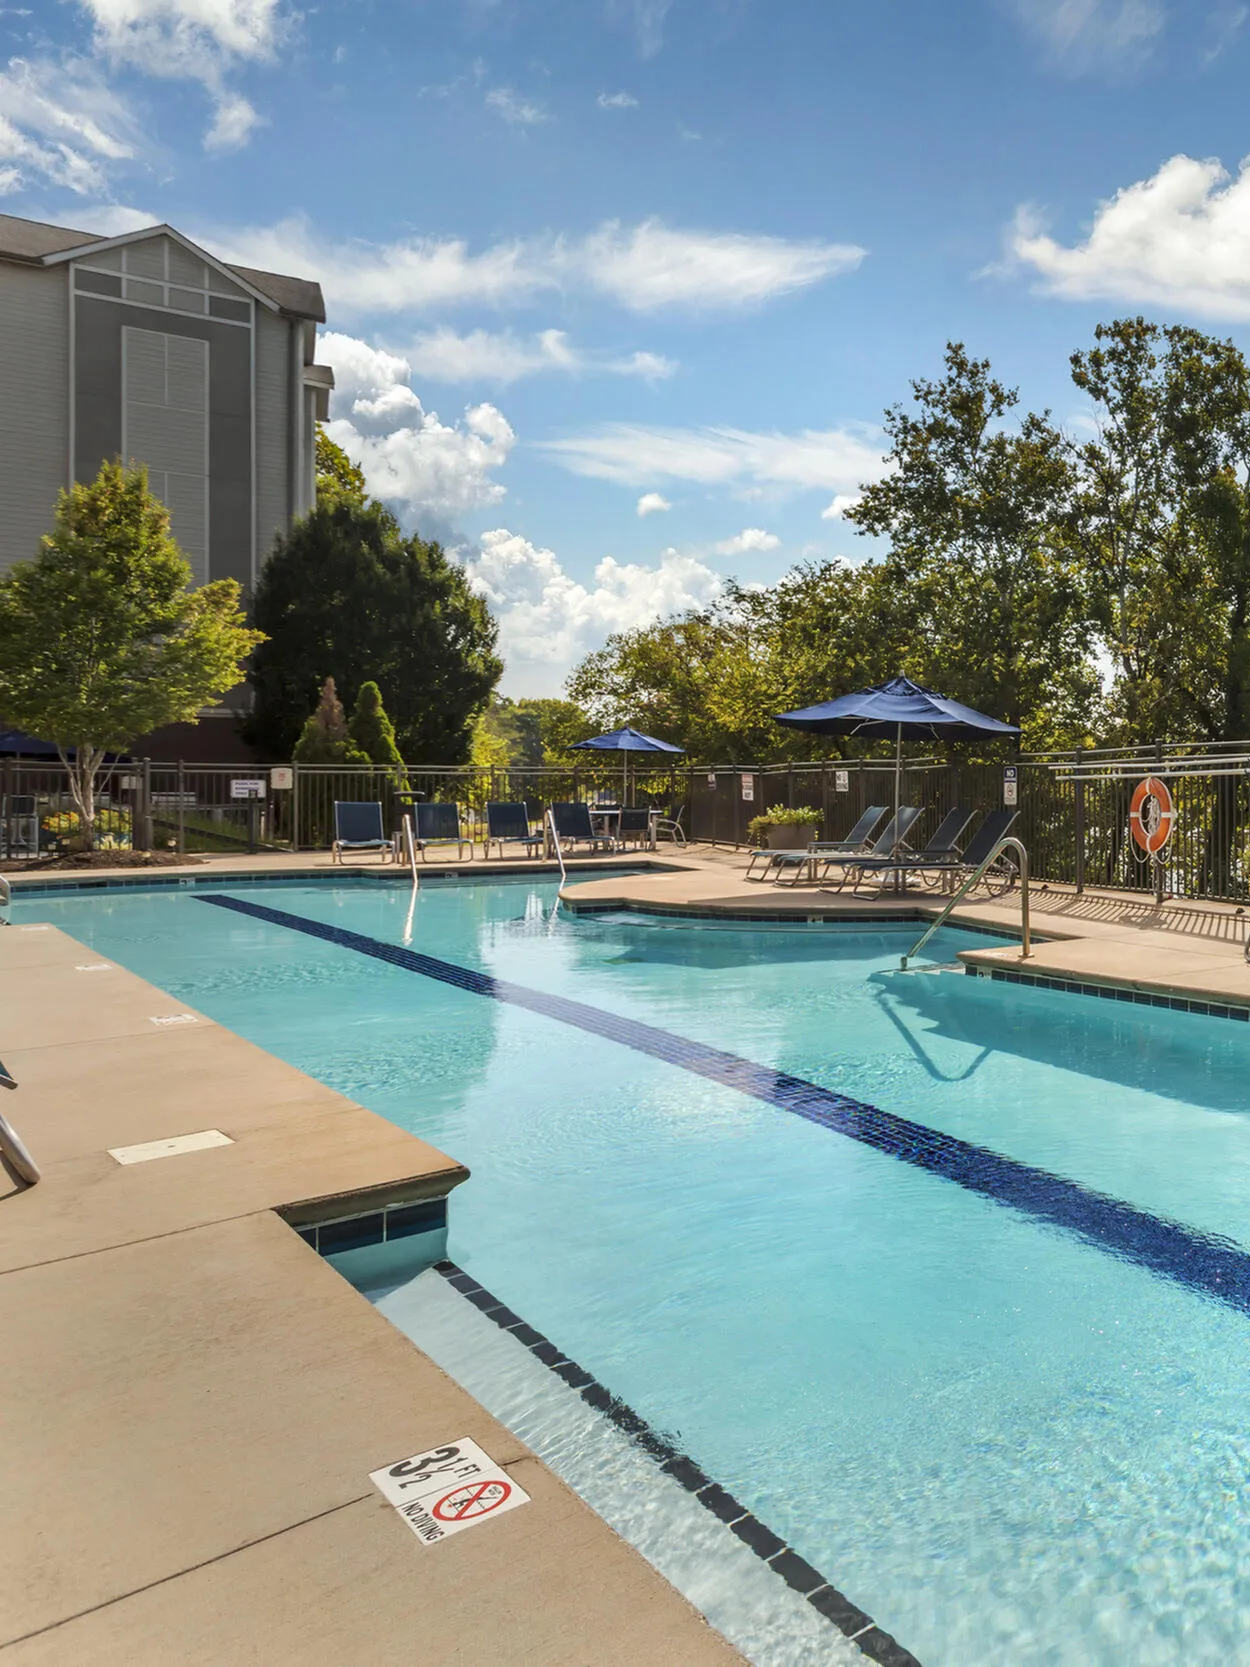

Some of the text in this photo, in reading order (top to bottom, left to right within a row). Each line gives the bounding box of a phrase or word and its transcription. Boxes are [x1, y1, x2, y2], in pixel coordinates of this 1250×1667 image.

[453, 1463, 482, 1479] FT
[401, 1501, 446, 1541] NO DIVING
